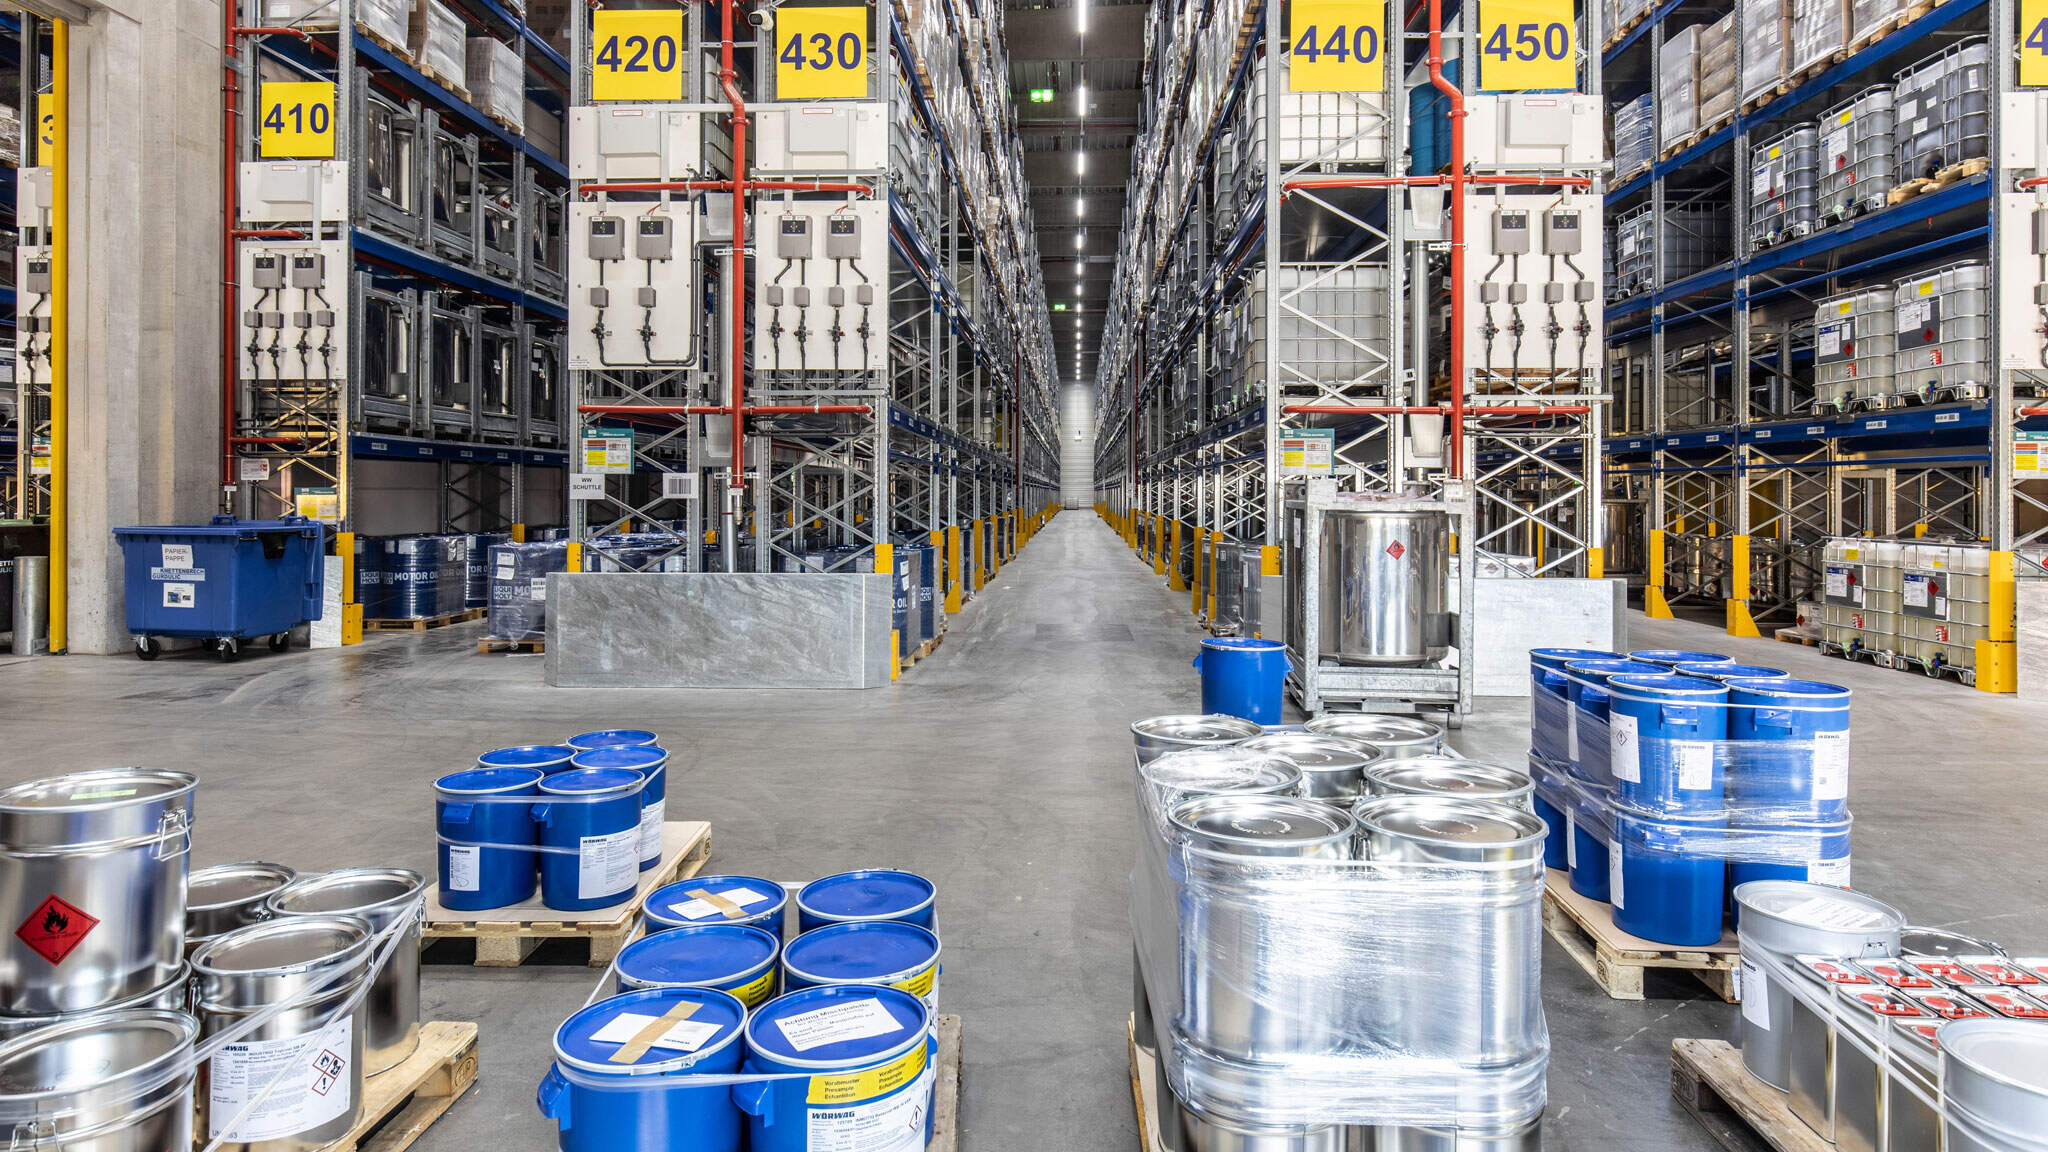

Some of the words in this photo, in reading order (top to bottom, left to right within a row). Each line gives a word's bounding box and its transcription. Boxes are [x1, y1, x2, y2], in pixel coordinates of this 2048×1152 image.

[596, 35, 677, 73] 420
[780, 32, 862, 70] 430
[1293, 25, 1378, 63] 440
[1484, 22, 1570, 62] 450
[263, 103, 329, 134] 410
[394, 571, 429, 581] MOTOR
[824, 1078, 860, 1086] Vorabmuster
[824, 1085, 854, 1093] Presample
